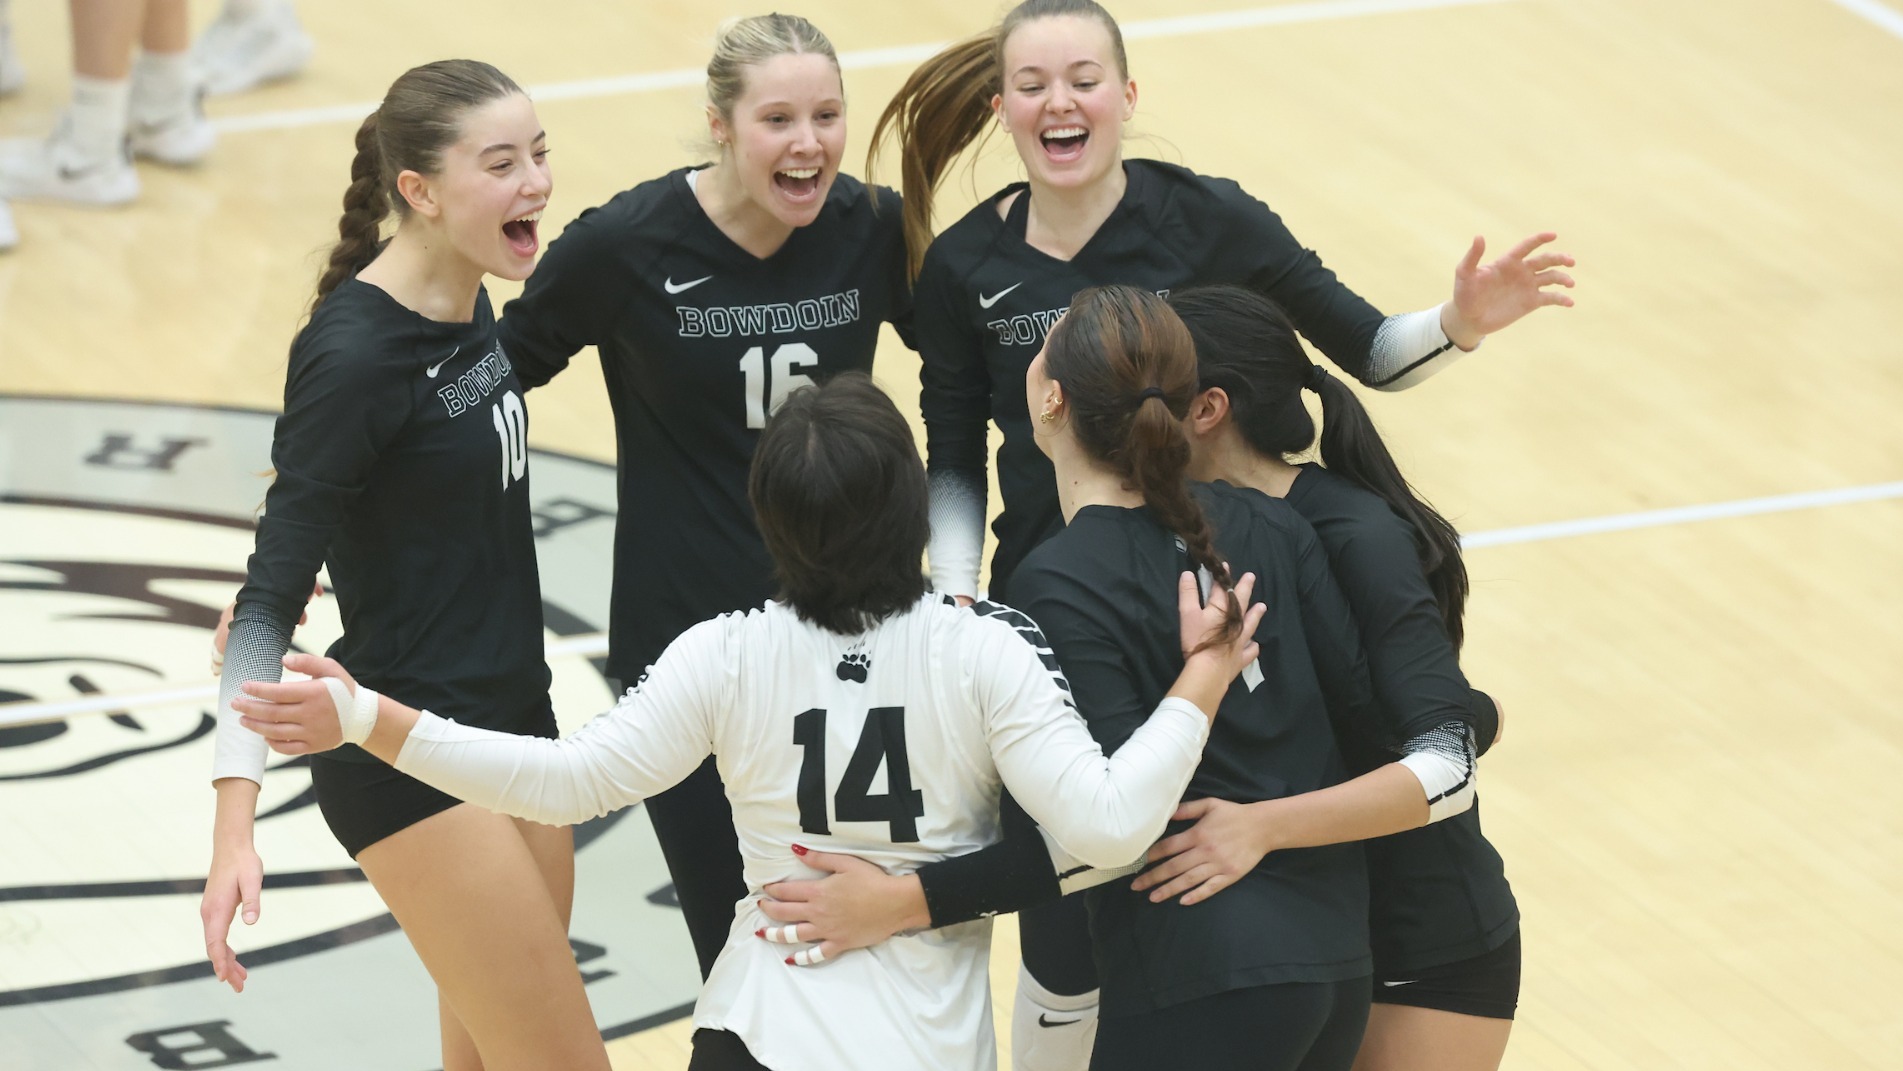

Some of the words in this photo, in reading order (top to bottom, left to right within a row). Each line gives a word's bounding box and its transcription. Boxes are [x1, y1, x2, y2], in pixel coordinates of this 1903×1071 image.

[675, 288, 862, 339] BOWDOIN
[739, 342, 819, 430] 16
[491, 389, 527, 493] 10
[792, 705, 926, 844] 14
